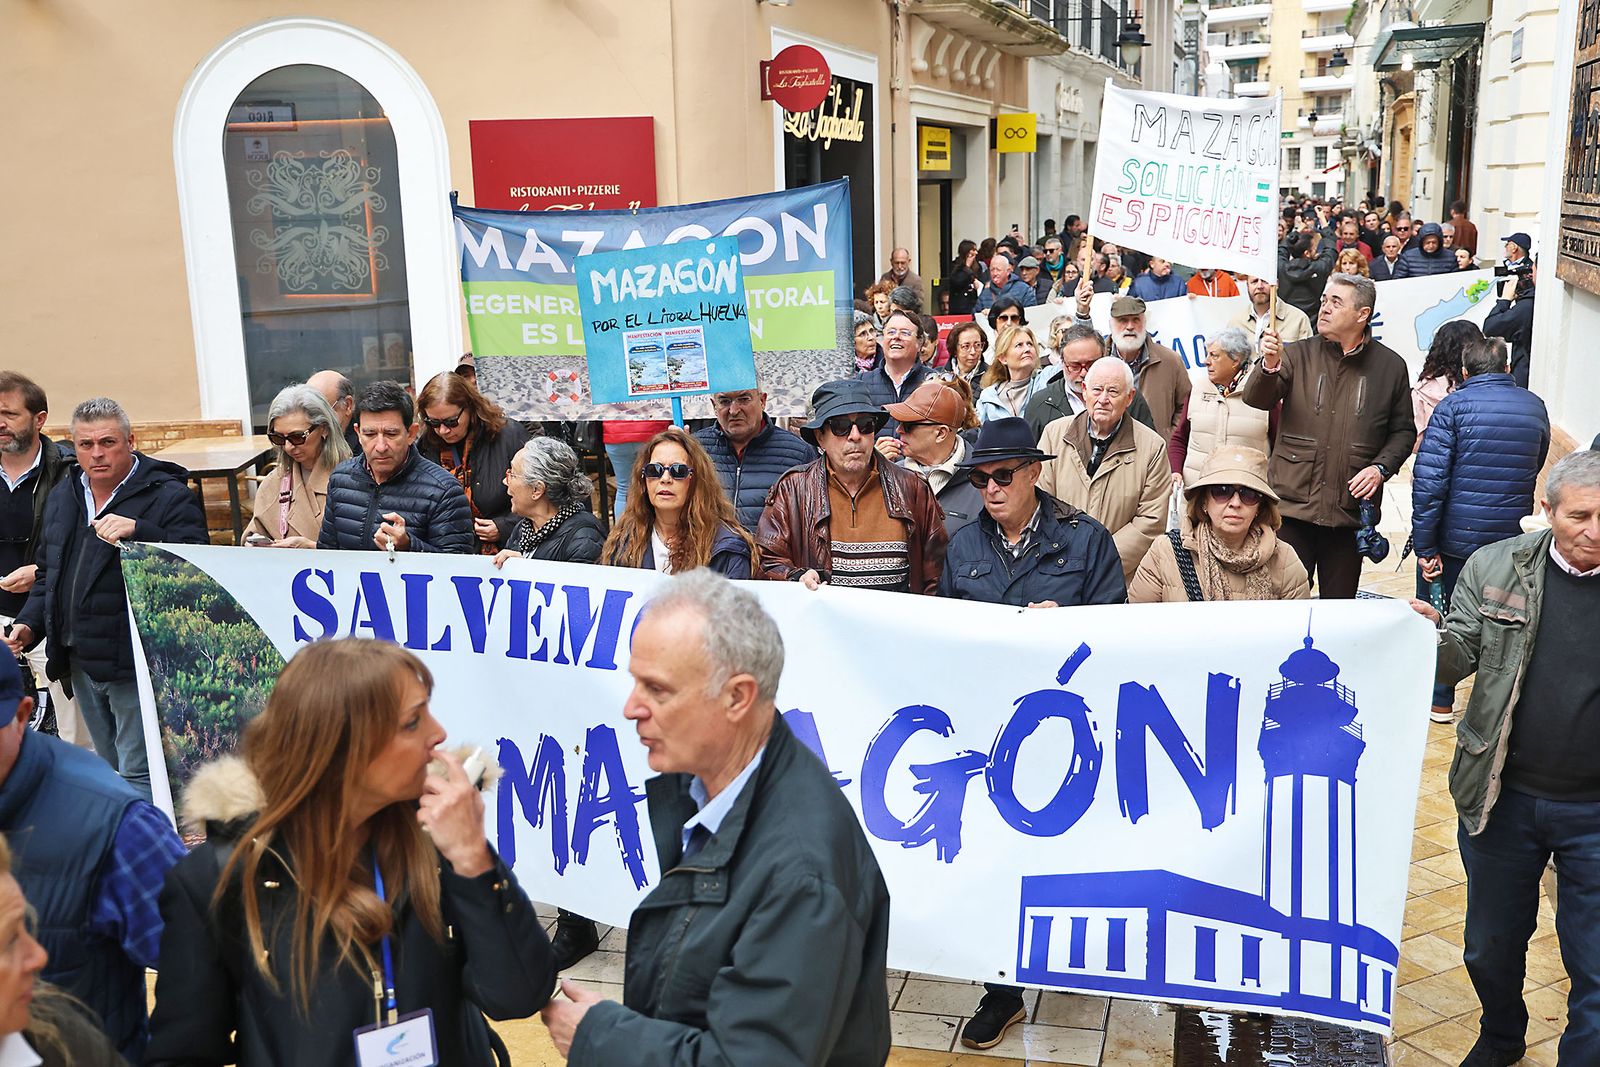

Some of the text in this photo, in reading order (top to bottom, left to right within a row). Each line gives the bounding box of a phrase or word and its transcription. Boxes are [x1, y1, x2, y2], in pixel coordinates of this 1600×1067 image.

[1131, 104, 1278, 167] MAZAGÓN
[1117, 158, 1252, 211] SOLUCIÓN
[1097, 193, 1262, 256] ESPIGÓN/ES
[590, 242, 738, 304] MAZAGÓN
[522, 323, 557, 345] ES
[593, 317, 620, 334] POR
[625, 313, 643, 328] EL
[700, 302, 747, 322] HUELVA
[291, 568, 645, 671] SALVEM
